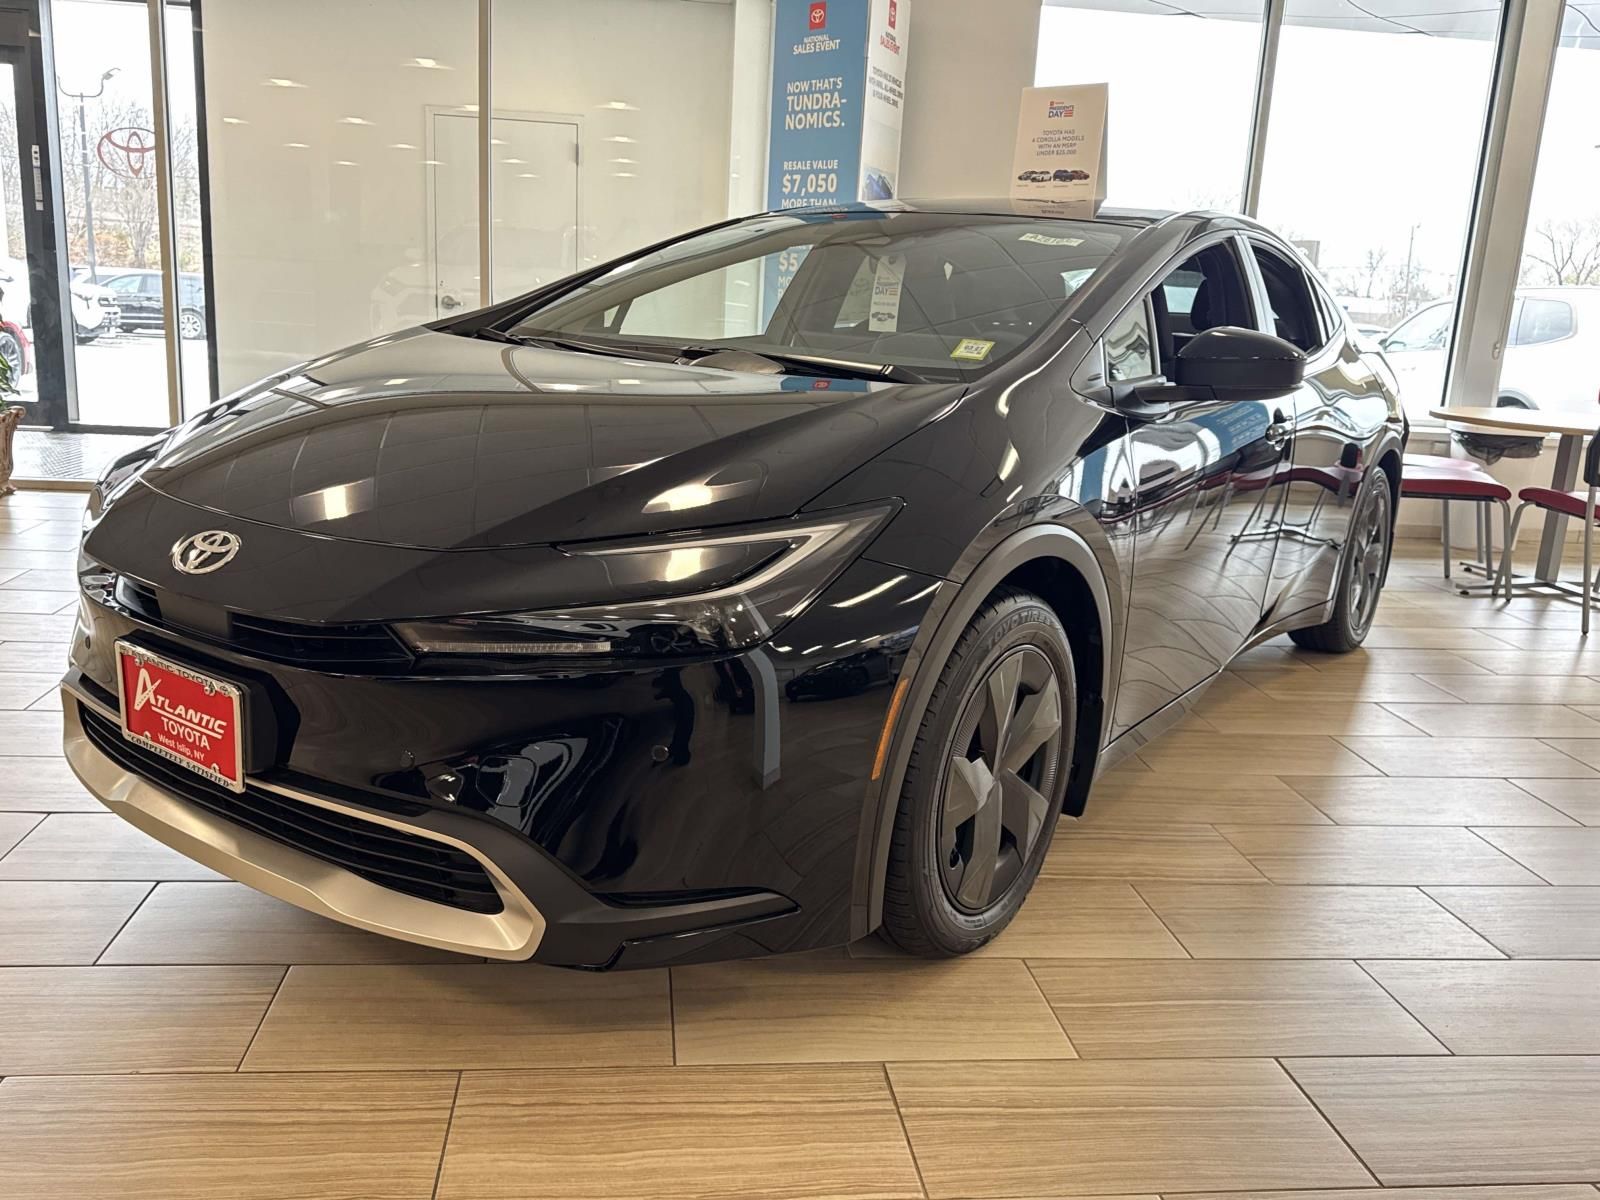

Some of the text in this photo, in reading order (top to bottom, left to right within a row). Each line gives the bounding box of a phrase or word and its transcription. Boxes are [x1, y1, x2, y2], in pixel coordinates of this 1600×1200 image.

[793, 39, 841, 55] SALES EVENT
[787, 77, 843, 93] NOW THAT'S
[786, 93, 848, 112] TUNDRA-
[785, 111, 846, 130] NOMICS.
[1048, 110, 1064, 119] DAY
[783, 159, 839, 171] RESALE VALUE
[782, 173, 837, 196] $7,050
[781, 198, 837, 209] MORE THAN
[176, 668, 215, 690] TOYOTA
[133, 668, 227, 734] ATLANTIC
[161, 716, 211, 751] TOYOTA
[158, 733, 205, 761] West Islip, NY
